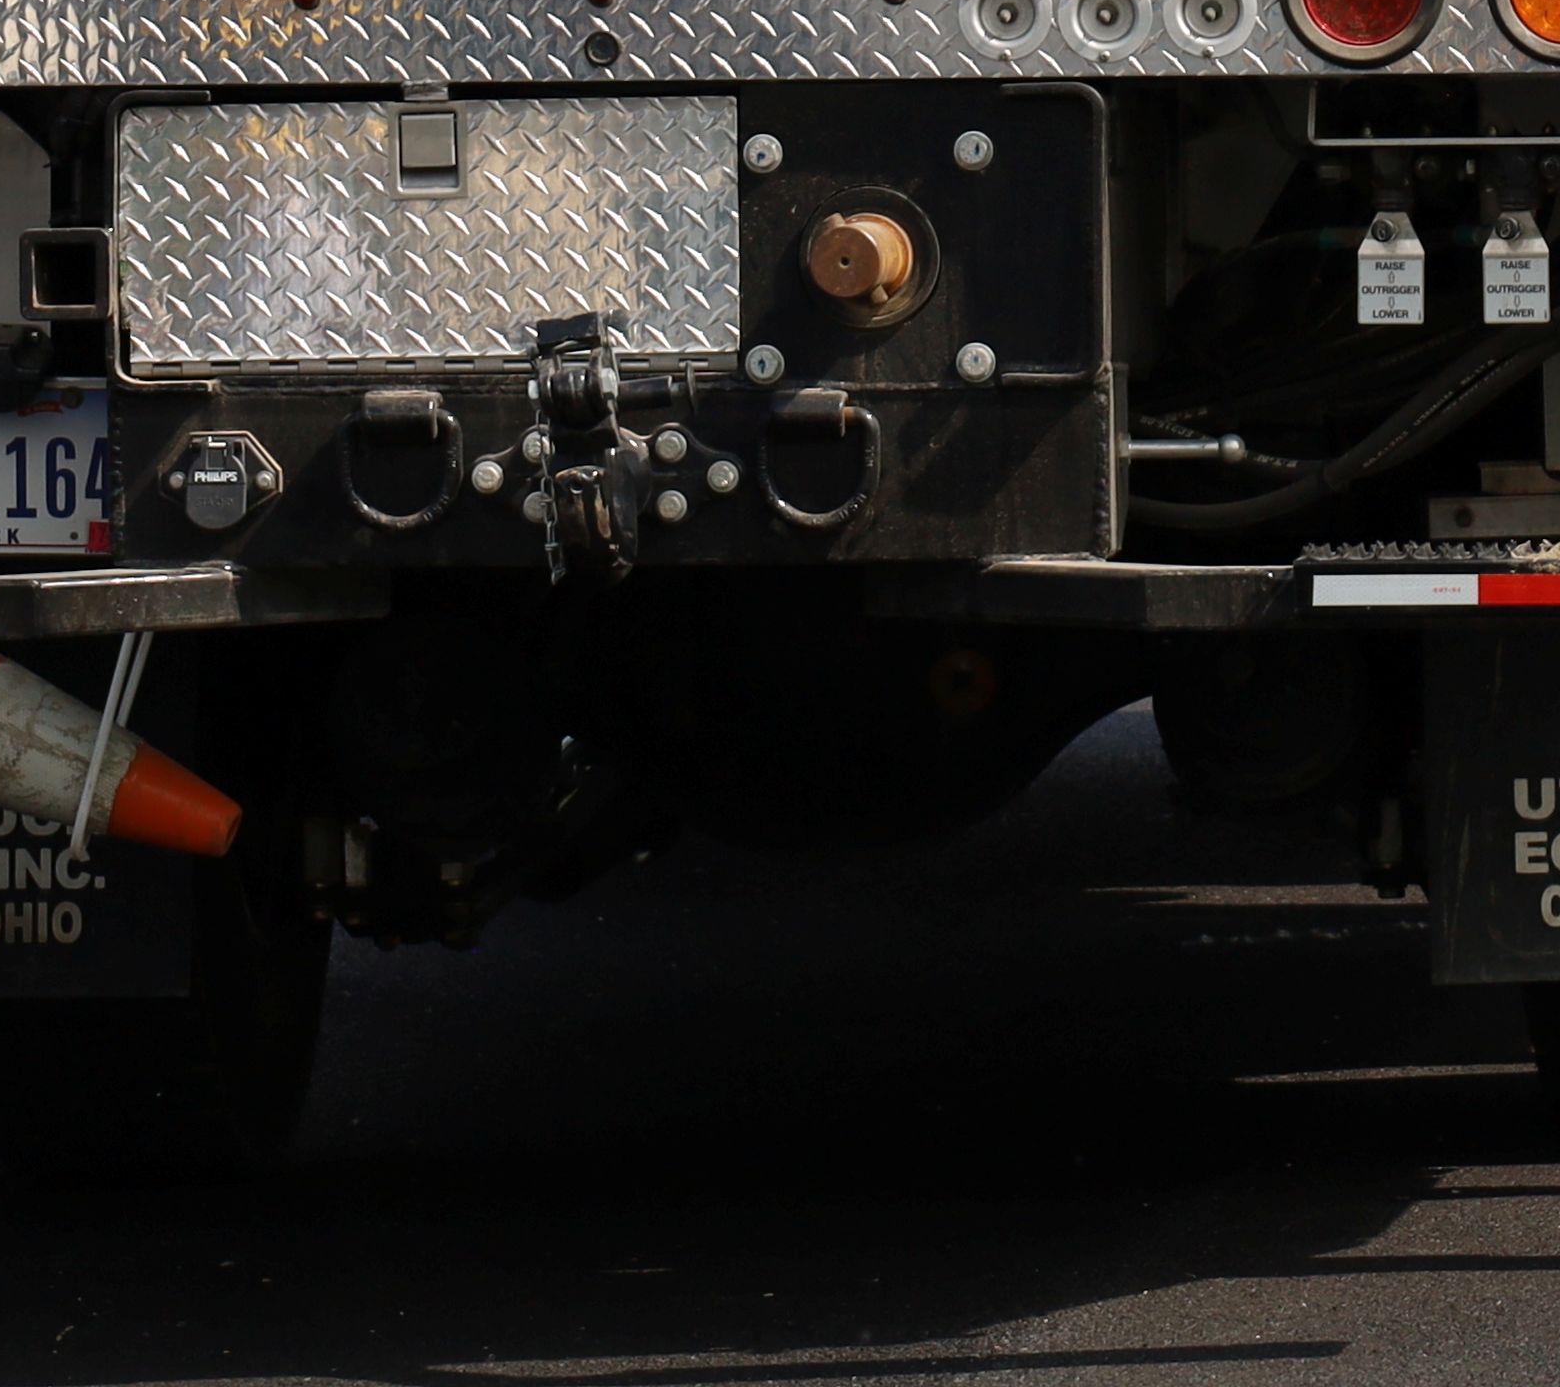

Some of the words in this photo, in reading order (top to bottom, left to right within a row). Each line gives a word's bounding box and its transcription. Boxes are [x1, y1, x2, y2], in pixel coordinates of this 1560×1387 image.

[1375, 261, 1405, 271] RAISE
[1500, 260, 1531, 270] RAISE
[1361, 286, 1420, 295] OUTRIGGER
[1487, 284, 1546, 294] OUTRIGGER
[1372, 309, 1409, 319] LOWER
[1498, 309, 1535, 318] LOWER
[194, 471, 238, 482] PHILLIPS
